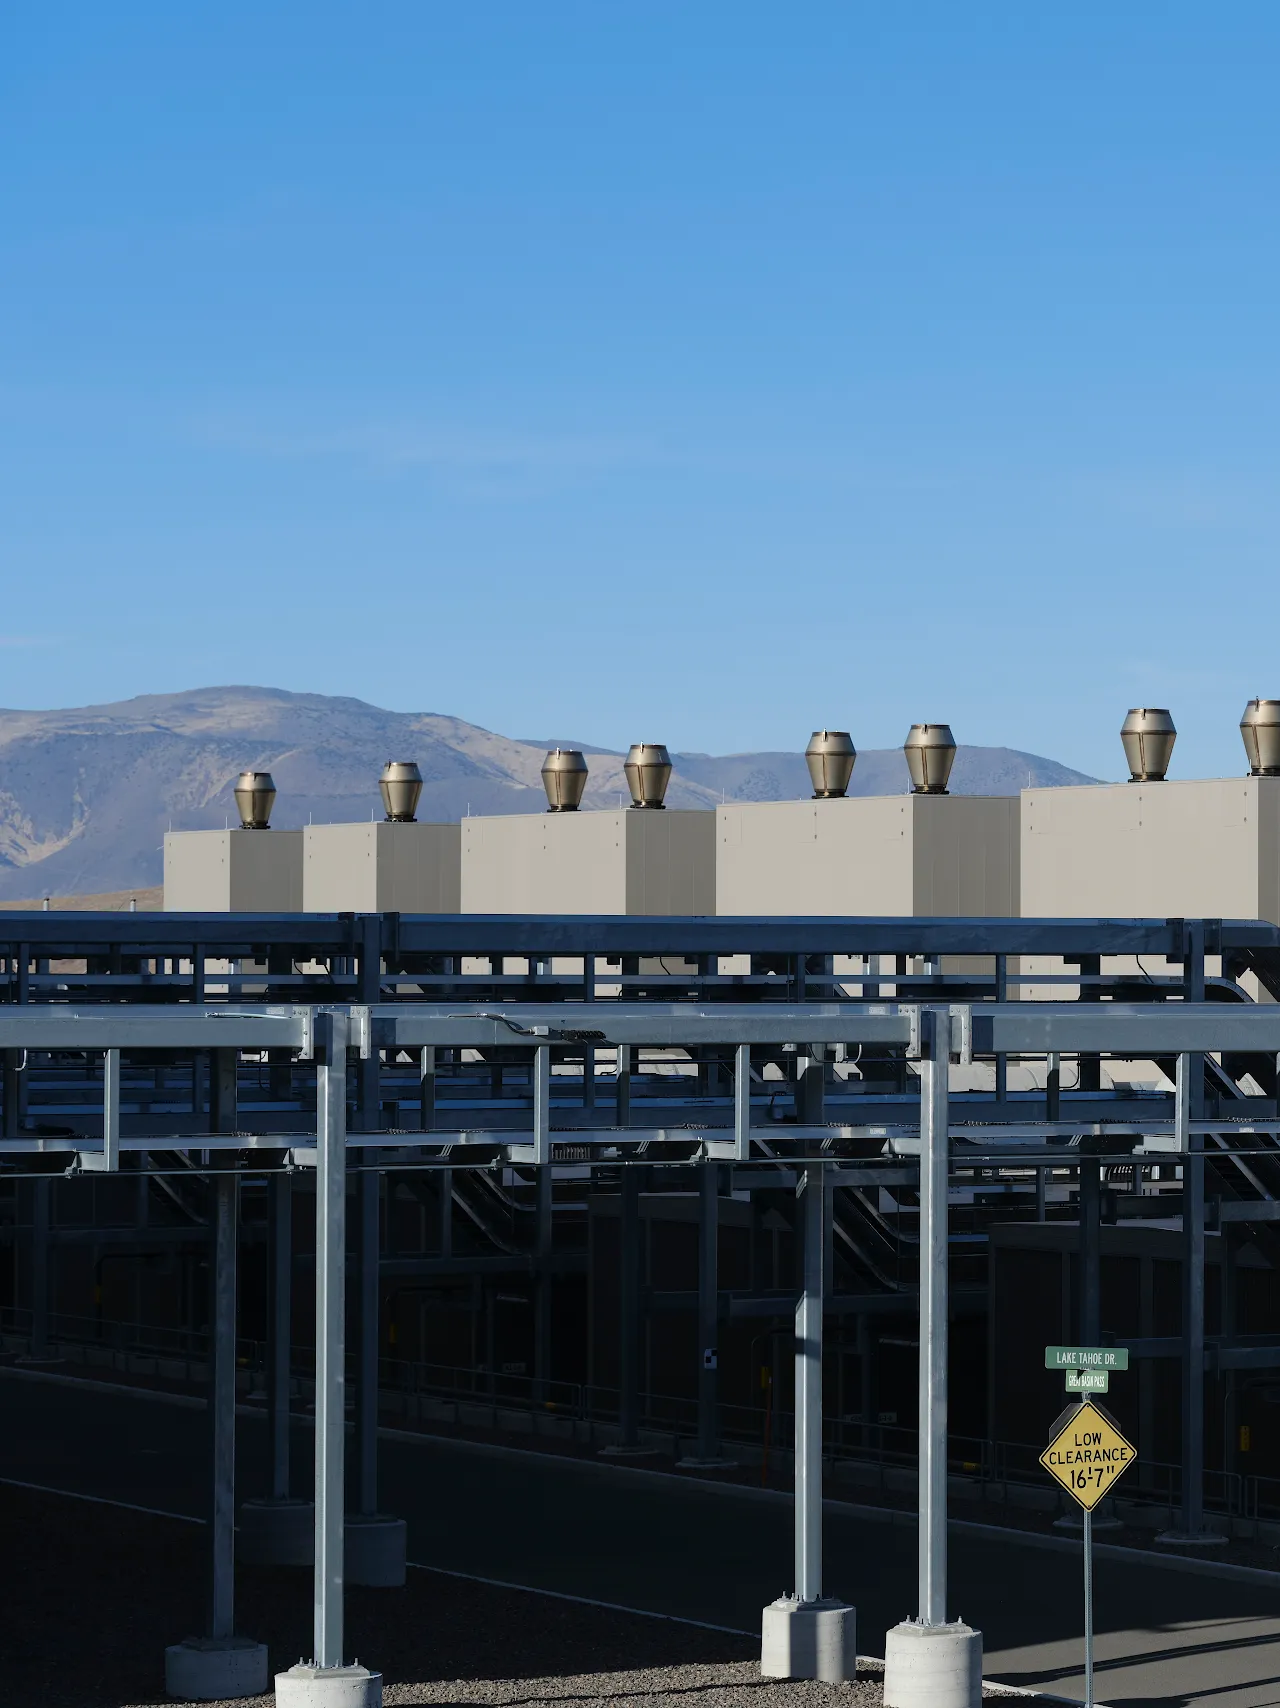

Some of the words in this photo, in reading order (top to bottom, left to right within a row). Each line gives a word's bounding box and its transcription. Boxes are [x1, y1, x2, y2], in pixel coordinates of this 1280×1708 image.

[1056, 1352, 1076, 1364] LAKE
[1079, 1352, 1102, 1365] TAHOE
[1104, 1353, 1117, 1365] DR.
[1081, 1375, 1093, 1387] BASIN
[1094, 1375, 1105, 1388] PASS
[1074, 1433, 1102, 1447] LOW
[1049, 1448, 1128, 1465] CLEARANCE
